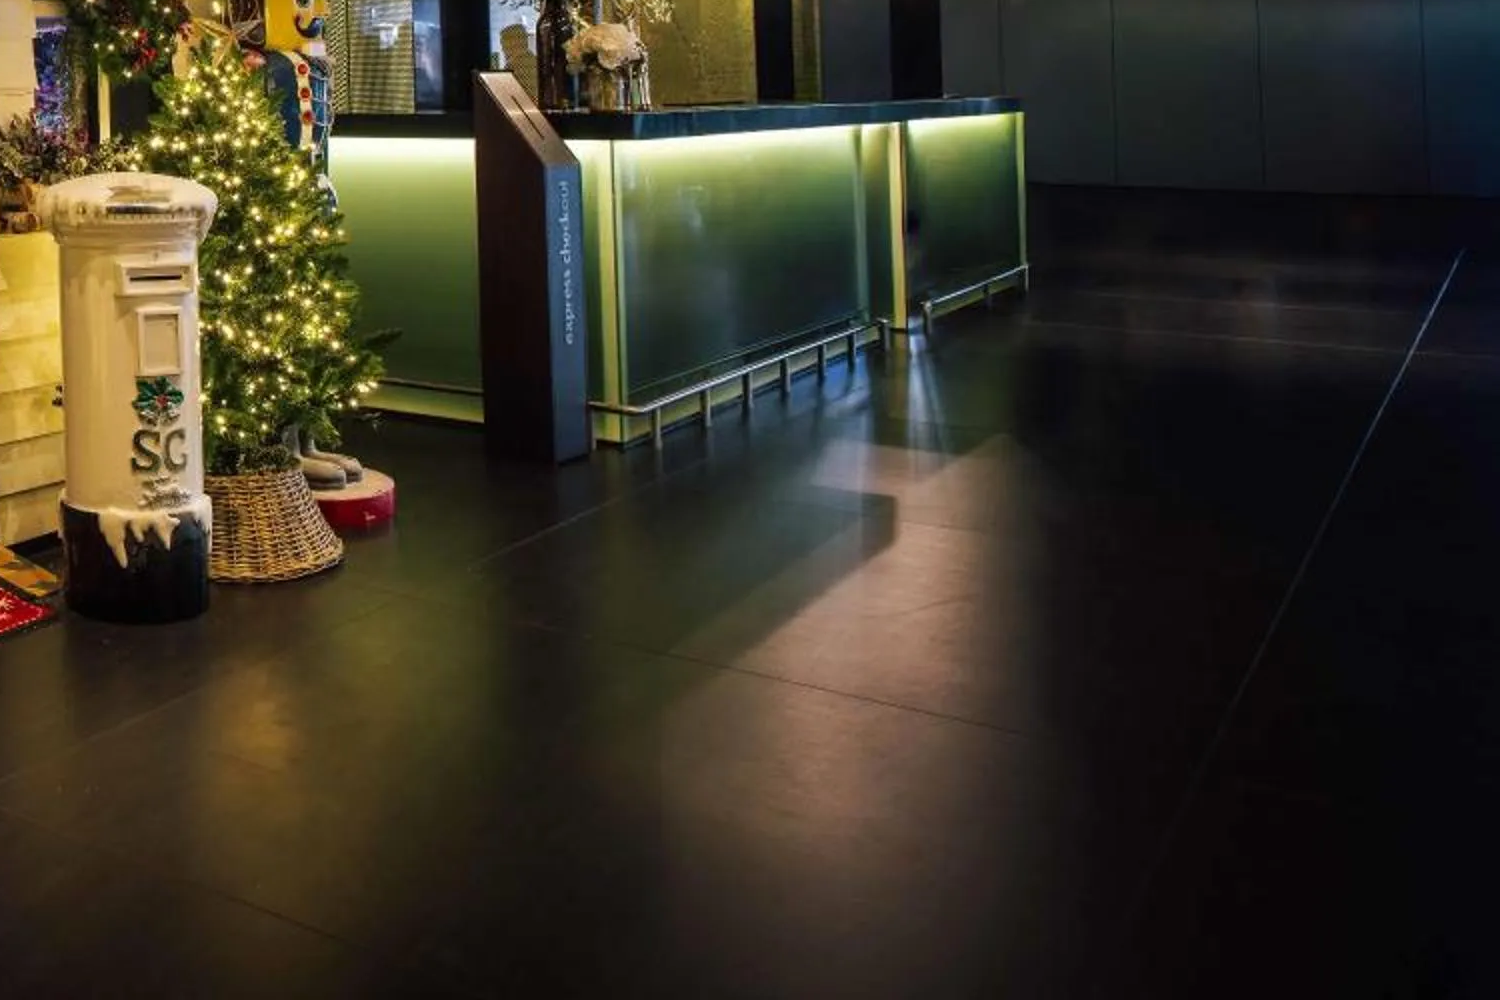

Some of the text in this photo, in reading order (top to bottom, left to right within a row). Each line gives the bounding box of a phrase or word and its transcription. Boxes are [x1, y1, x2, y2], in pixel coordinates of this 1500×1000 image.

[557, 180, 576, 345] express checkout
[130, 427, 187, 474] SC
